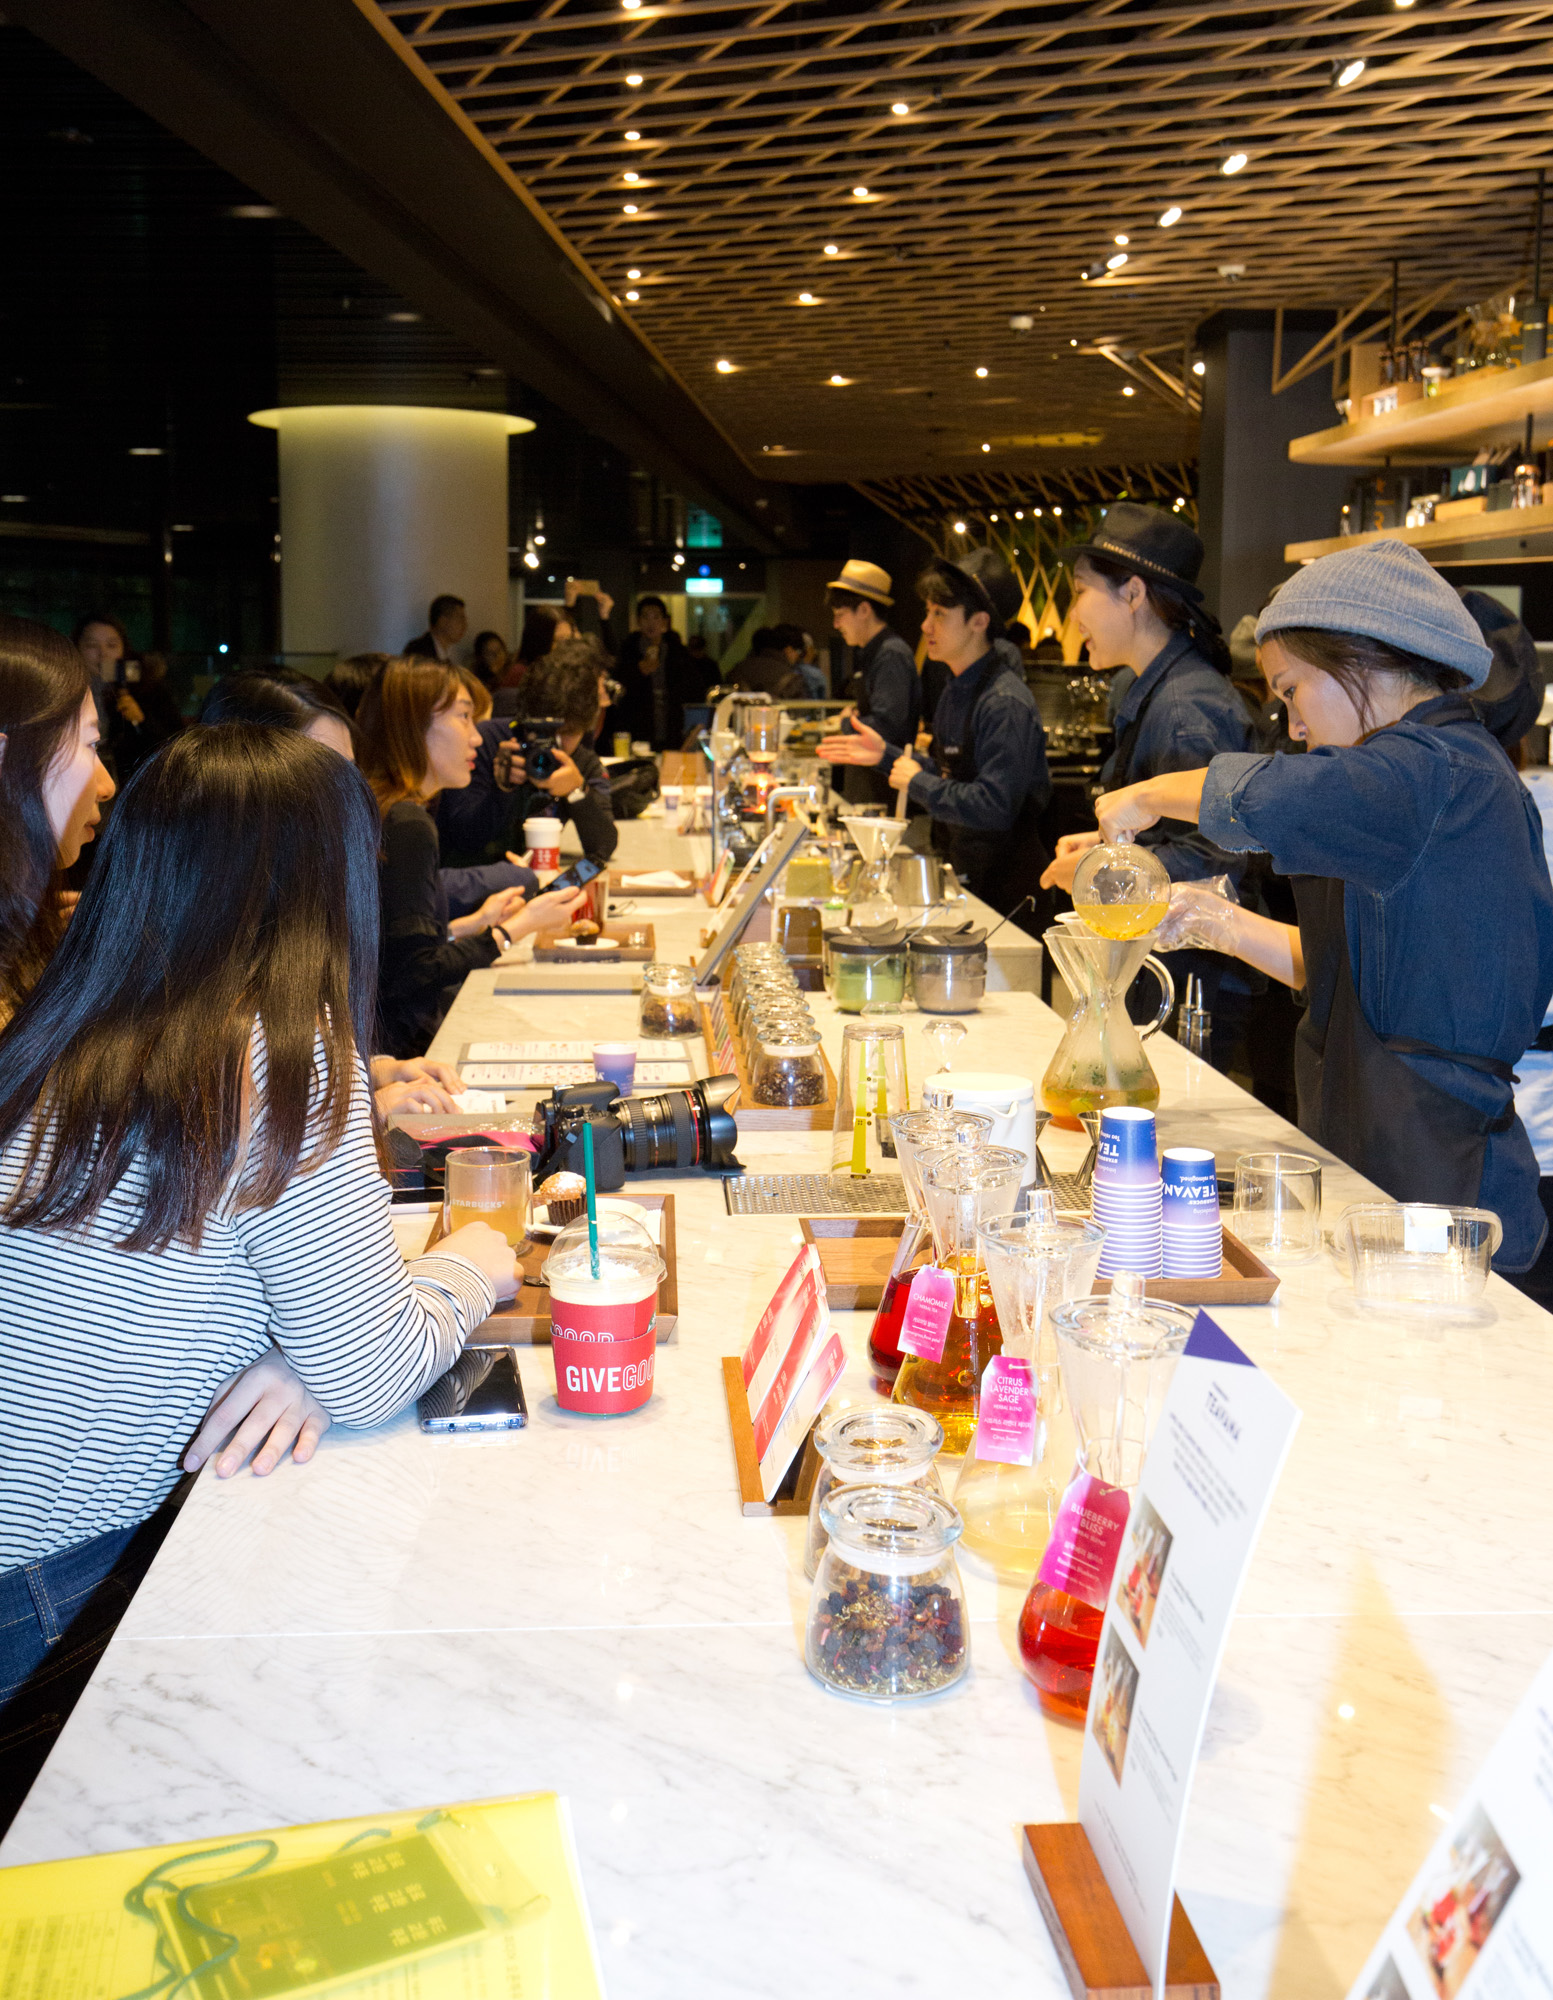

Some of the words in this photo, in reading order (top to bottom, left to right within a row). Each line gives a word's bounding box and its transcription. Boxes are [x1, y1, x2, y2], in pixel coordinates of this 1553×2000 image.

[913, 1293, 948, 1310] CHAMOMILE
[996, 1376, 1023, 1387] CITRUS
[989, 1384, 1029, 1397] LAVENDER
[998, 1393, 1019, 1404] SAGE
[1070, 1502, 1120, 1532] BLUEBERRY
[1080, 1519, 1104, 1536] BLISS
